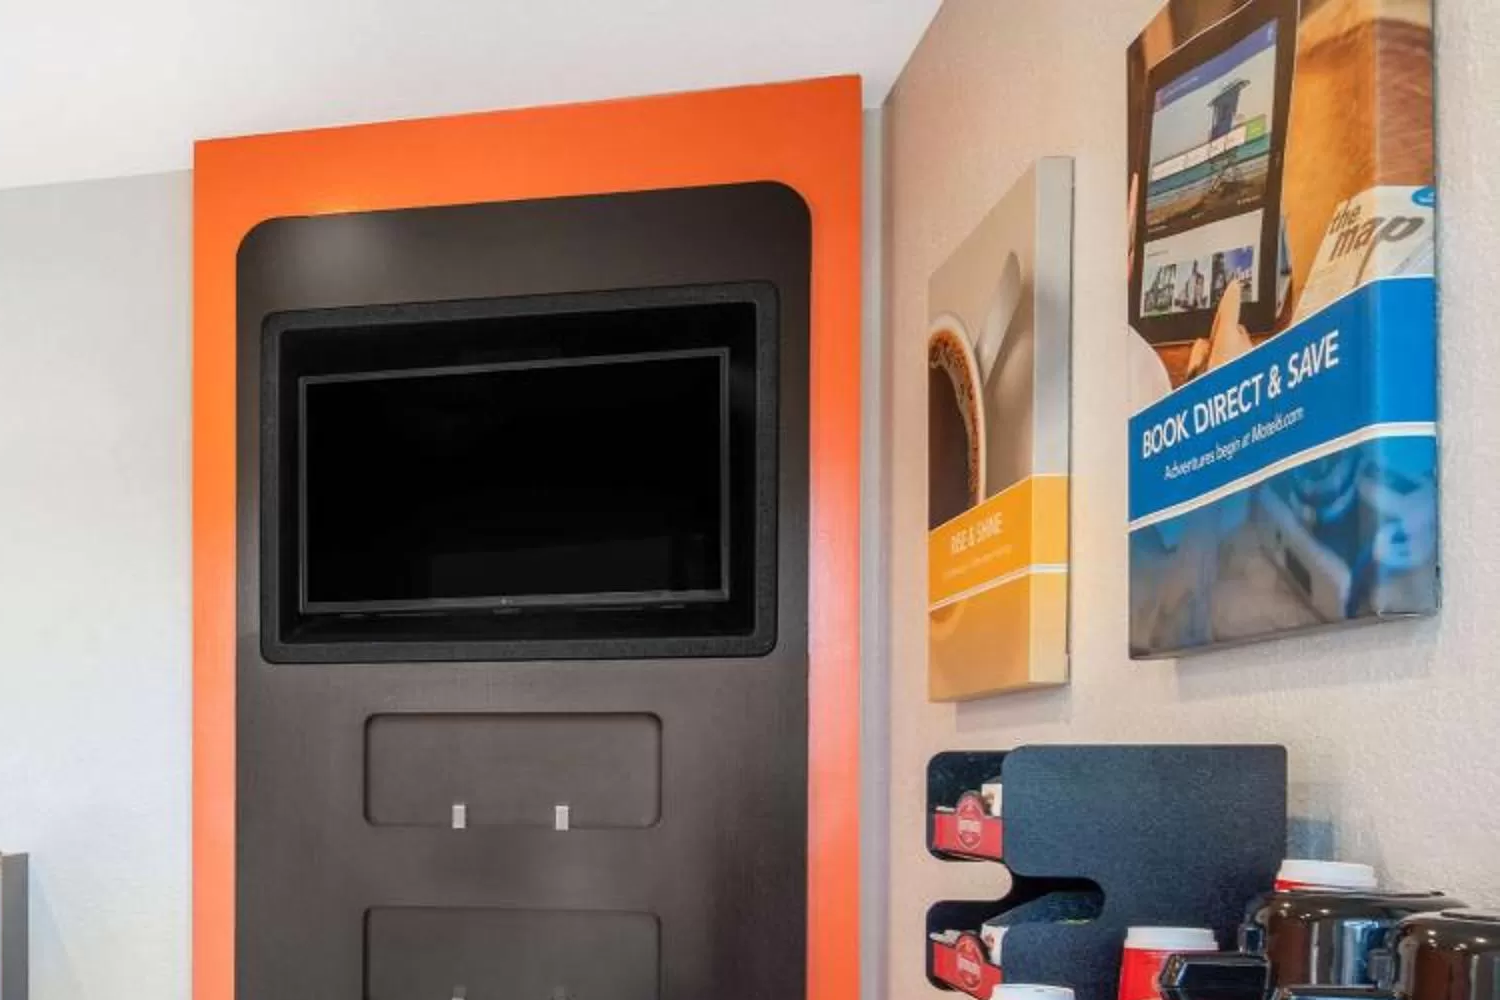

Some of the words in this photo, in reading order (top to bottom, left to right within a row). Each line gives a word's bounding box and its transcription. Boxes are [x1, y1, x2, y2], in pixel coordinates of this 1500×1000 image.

[1142, 410, 1190, 459] BOOK
[1193, 372, 1264, 435] DIRECT
[1267, 364, 1282, 399] &
[1287, 329, 1340, 388] SAVE
